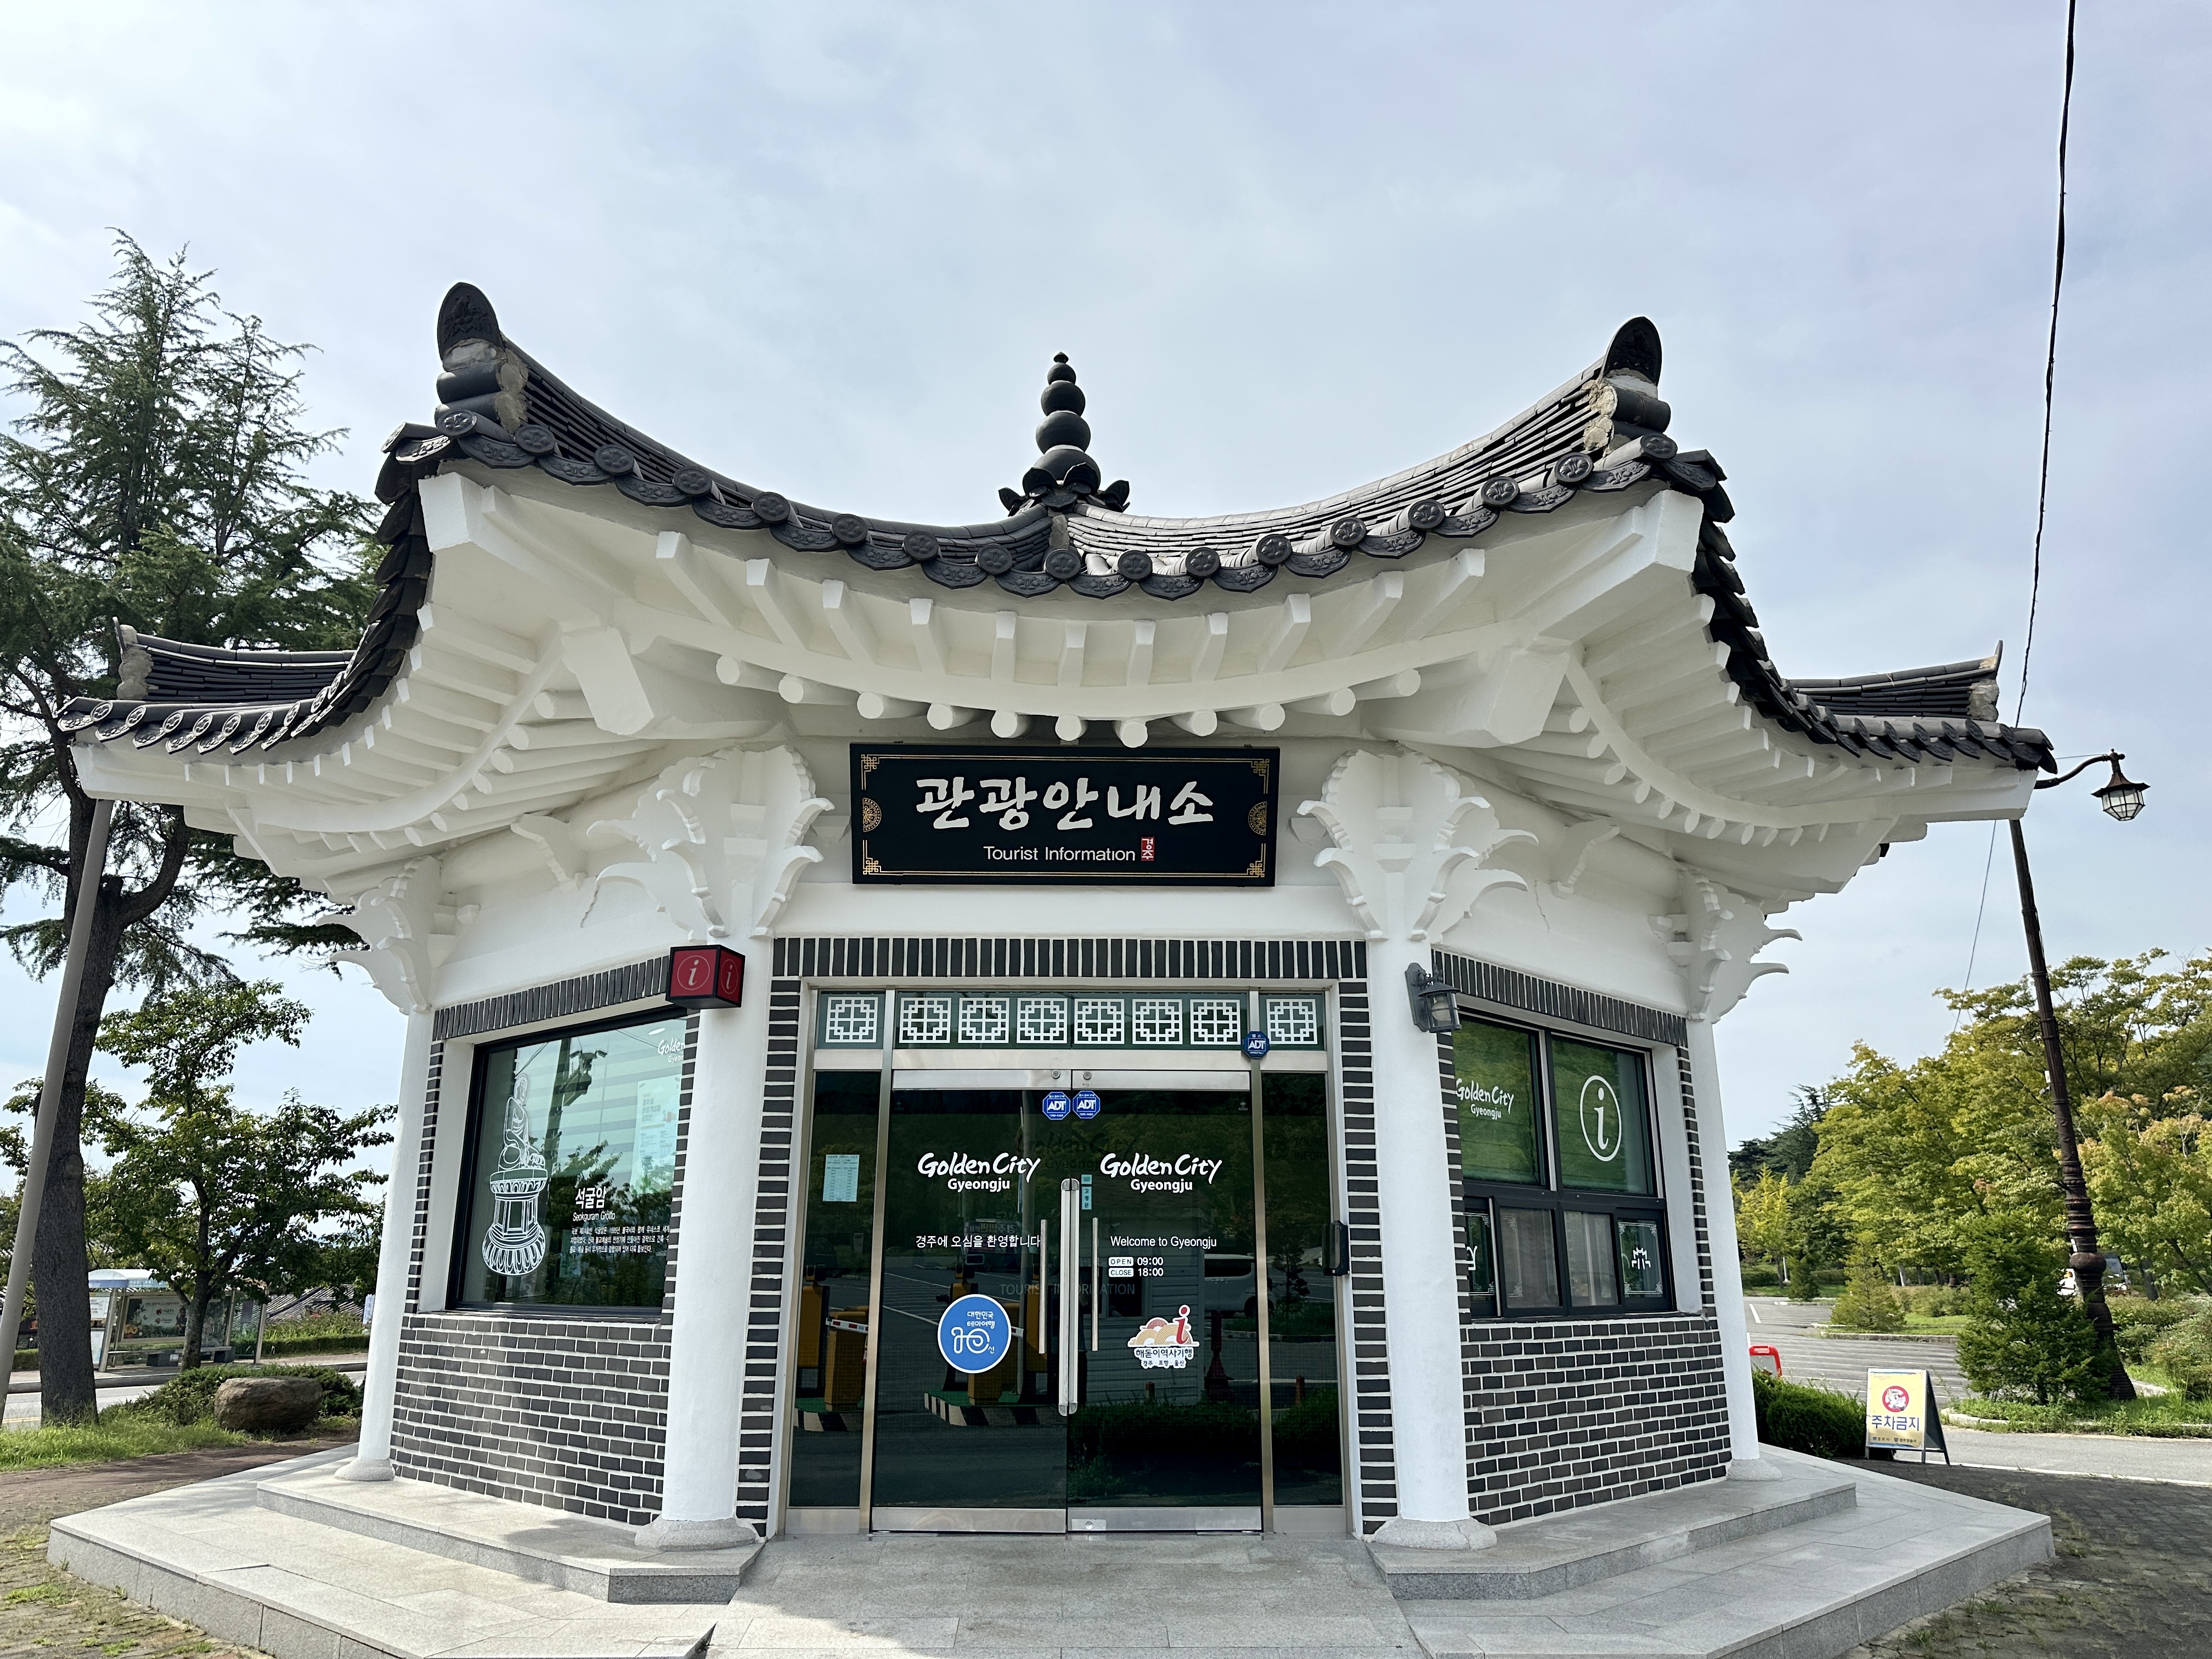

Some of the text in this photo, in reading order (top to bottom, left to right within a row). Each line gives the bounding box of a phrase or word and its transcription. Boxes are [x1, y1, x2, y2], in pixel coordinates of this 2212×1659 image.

[916, 776, 1214, 831] 관광안내소
[983, 846, 1136, 861] Tourist Information
[1248, 1040, 1266, 1049] ADT
[1455, 1078, 1514, 1114] Golden City
[1047, 1101, 1066, 1111] ADT
[1076, 1099, 1096, 1109] ADT
[1471, 1104, 1502, 1120] Gyeongju
[917, 1152, 1041, 1183] Golden City
[1100, 1153, 1222, 1184] Golden City
[947, 1177, 1010, 1193] Gyeongju
[1130, 1178, 1193, 1193] Gyeongju
[575, 1186, 607, 1209] 석굴암
[916, 1235, 1041, 1248] 경주에 오심을 환영합니다
[1110, 1236, 1217, 1249] Welcome to Gyeongju
[1137, 1257, 1164, 1266] 09:00
[1138, 1268, 1164, 1277] 18:00
[967, 1311, 994, 1319] 대한민국
[967, 1321, 995, 1329] 테마여행
[1136, 1349, 1192, 1358] 해돋이역사기행
[1871, 1415, 1920, 1432] 주차금지
